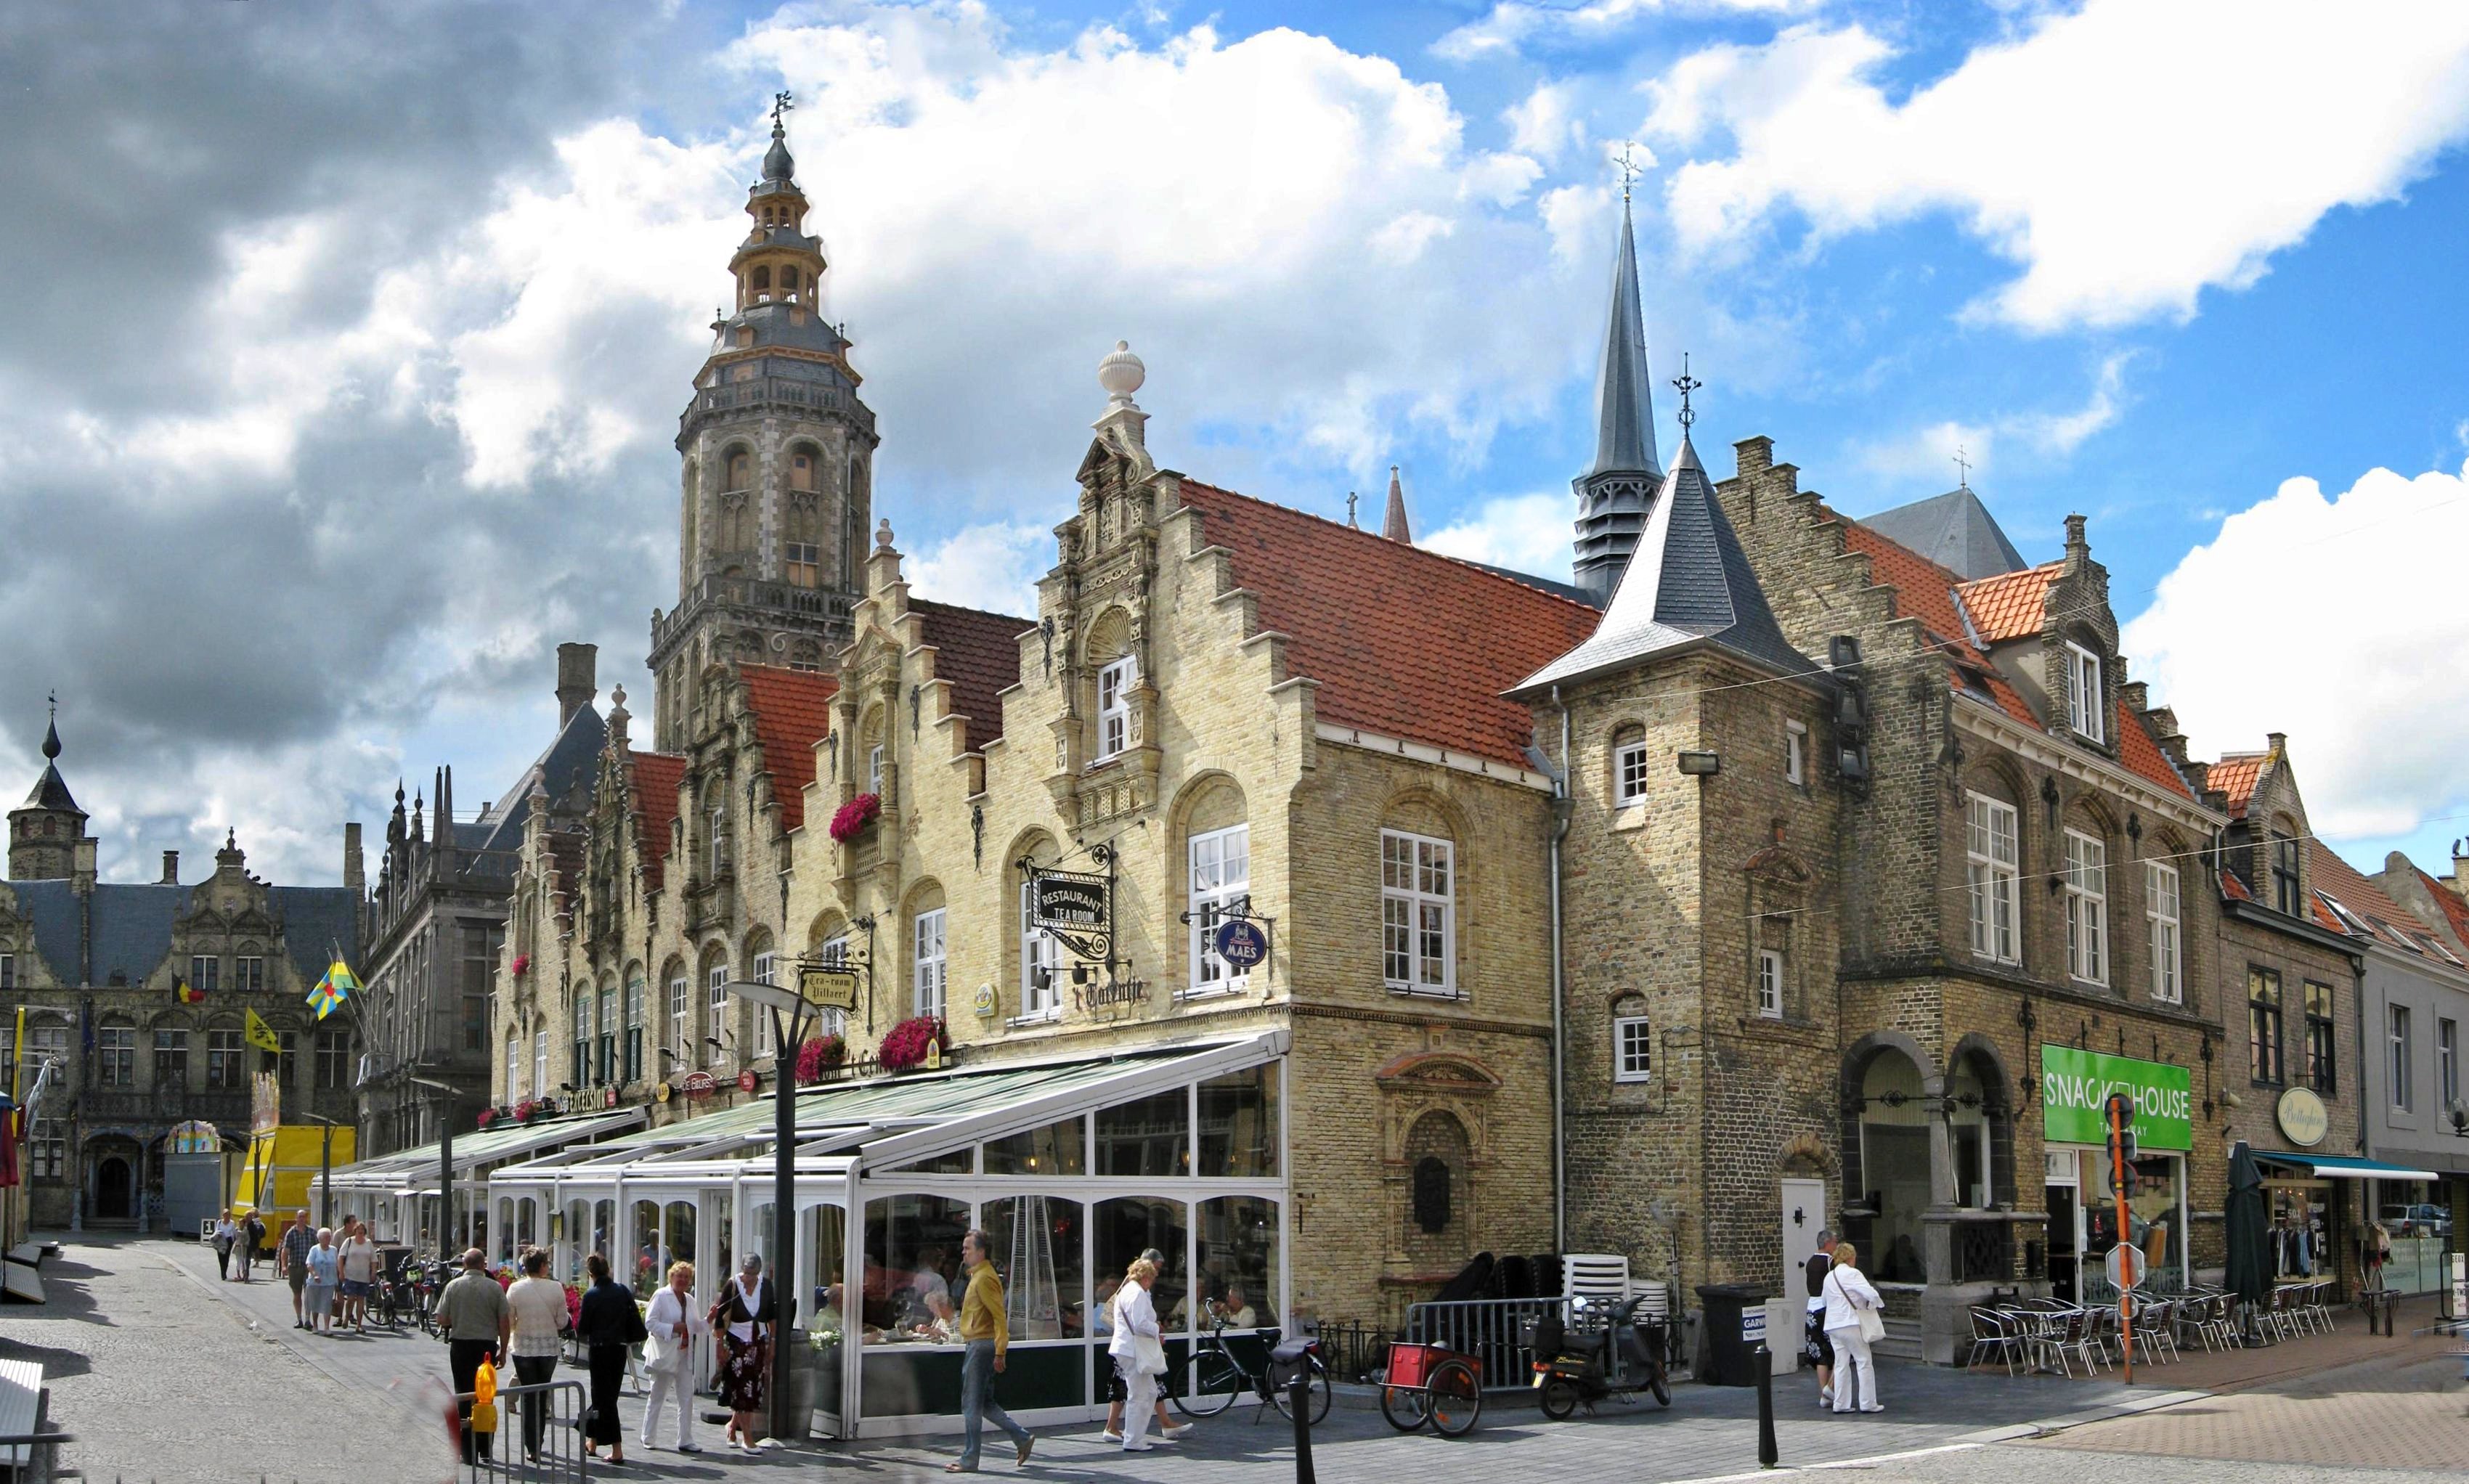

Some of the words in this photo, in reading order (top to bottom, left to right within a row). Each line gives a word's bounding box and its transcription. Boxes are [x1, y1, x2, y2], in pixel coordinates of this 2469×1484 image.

[1041, 889, 1102, 913] RESTAURANT
[1054, 907, 1071, 921] TEA
[1071, 908, 1095, 923] ROOM
[1225, 945, 1257, 959] MAES
[569, 1088, 606, 1113] EXCELSIOR
[2046, 1072, 2112, 1111] SNACK
[2132, 1084, 2189, 1120] HOUSE
